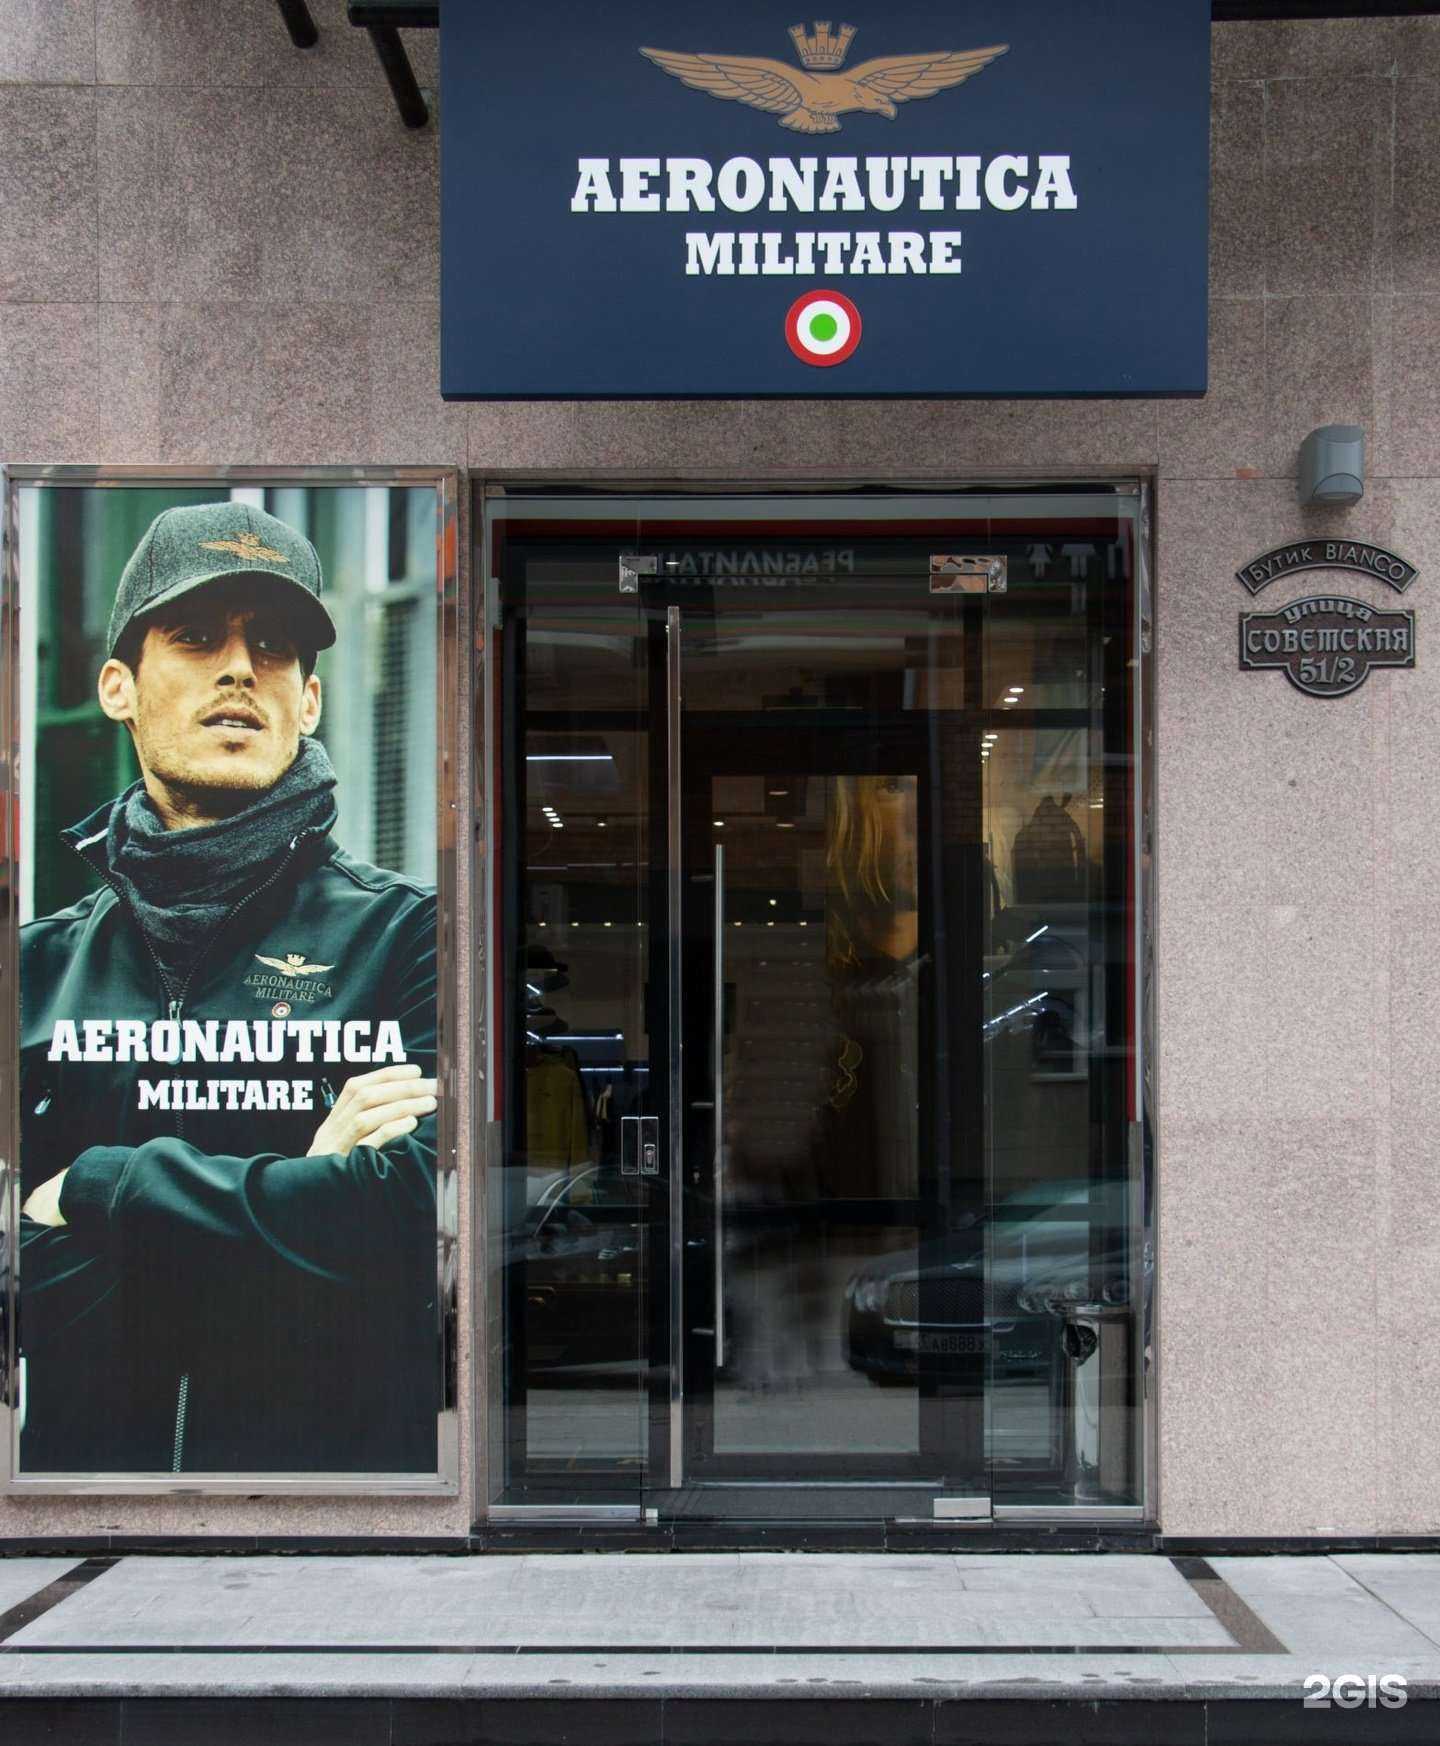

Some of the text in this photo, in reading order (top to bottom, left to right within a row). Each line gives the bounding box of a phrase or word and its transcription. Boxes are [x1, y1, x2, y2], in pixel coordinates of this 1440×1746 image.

[571, 155, 1078, 213] AERONAUTICA
[685, 231, 962, 275] MILITARE
[1250, 543, 1406, 582] БУТИК BIANCO
[1247, 627, 1409, 652] СОВЕТСКАЯ
[1300, 656, 1357, 684] 51/2
[243, 974, 332, 997] AERONAUTICA
[255, 987, 316, 1003] MILITARE
[47, 1019, 407, 1063] AERONAUTICA
[137, 1079, 314, 1111] MILITARE
